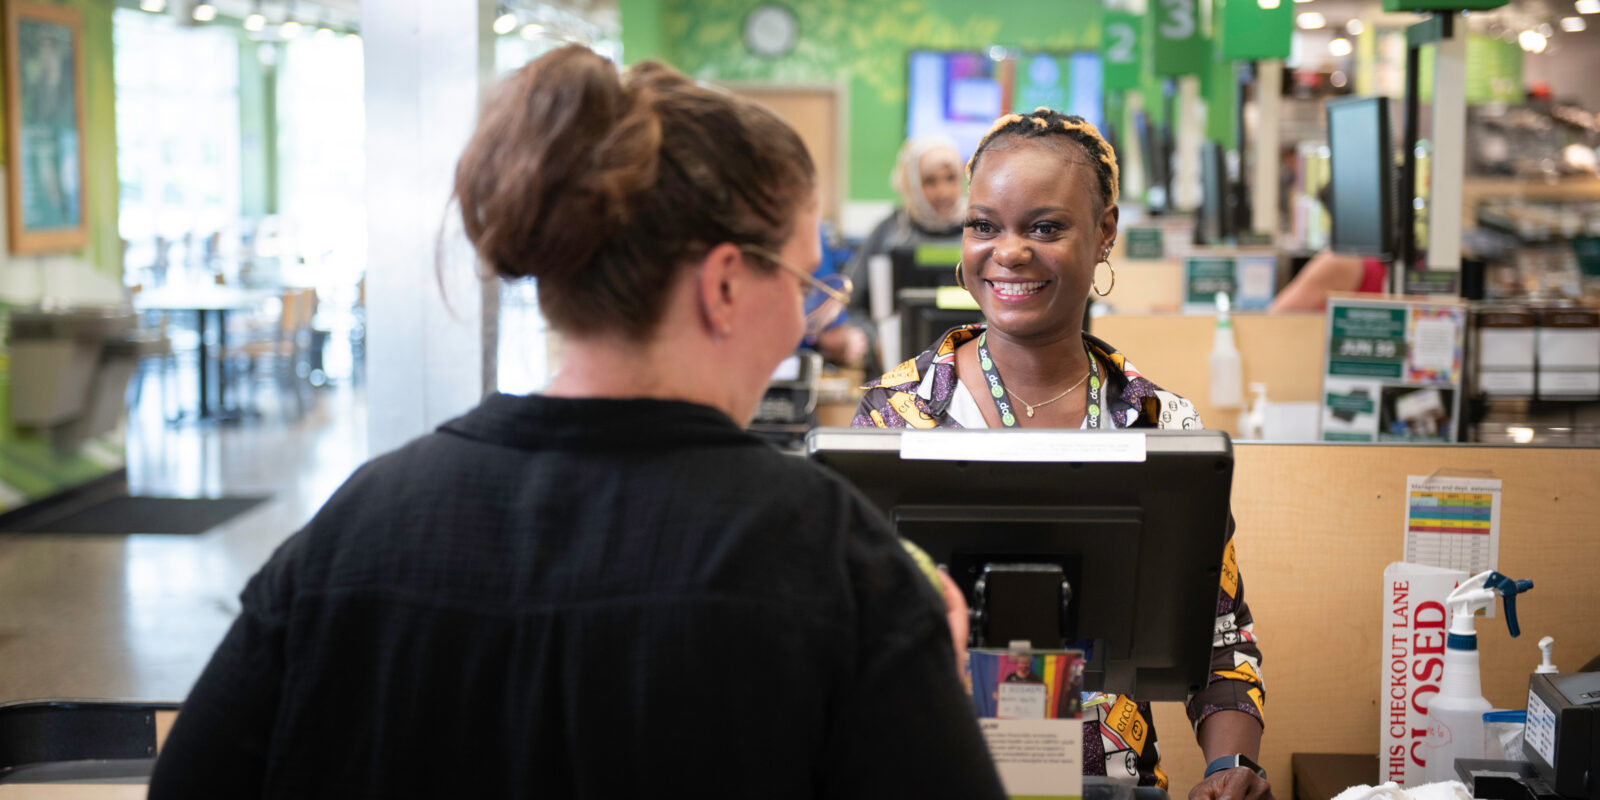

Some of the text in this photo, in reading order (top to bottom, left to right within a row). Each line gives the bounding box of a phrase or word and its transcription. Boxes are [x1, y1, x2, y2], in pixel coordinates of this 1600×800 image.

[1159, 0, 1196, 40] 3
[1107, 22, 1136, 63] 2
[1339, 338, 1372, 356] JUN
[1389, 580, 1409, 785] THIS CHECKOUT LANE
